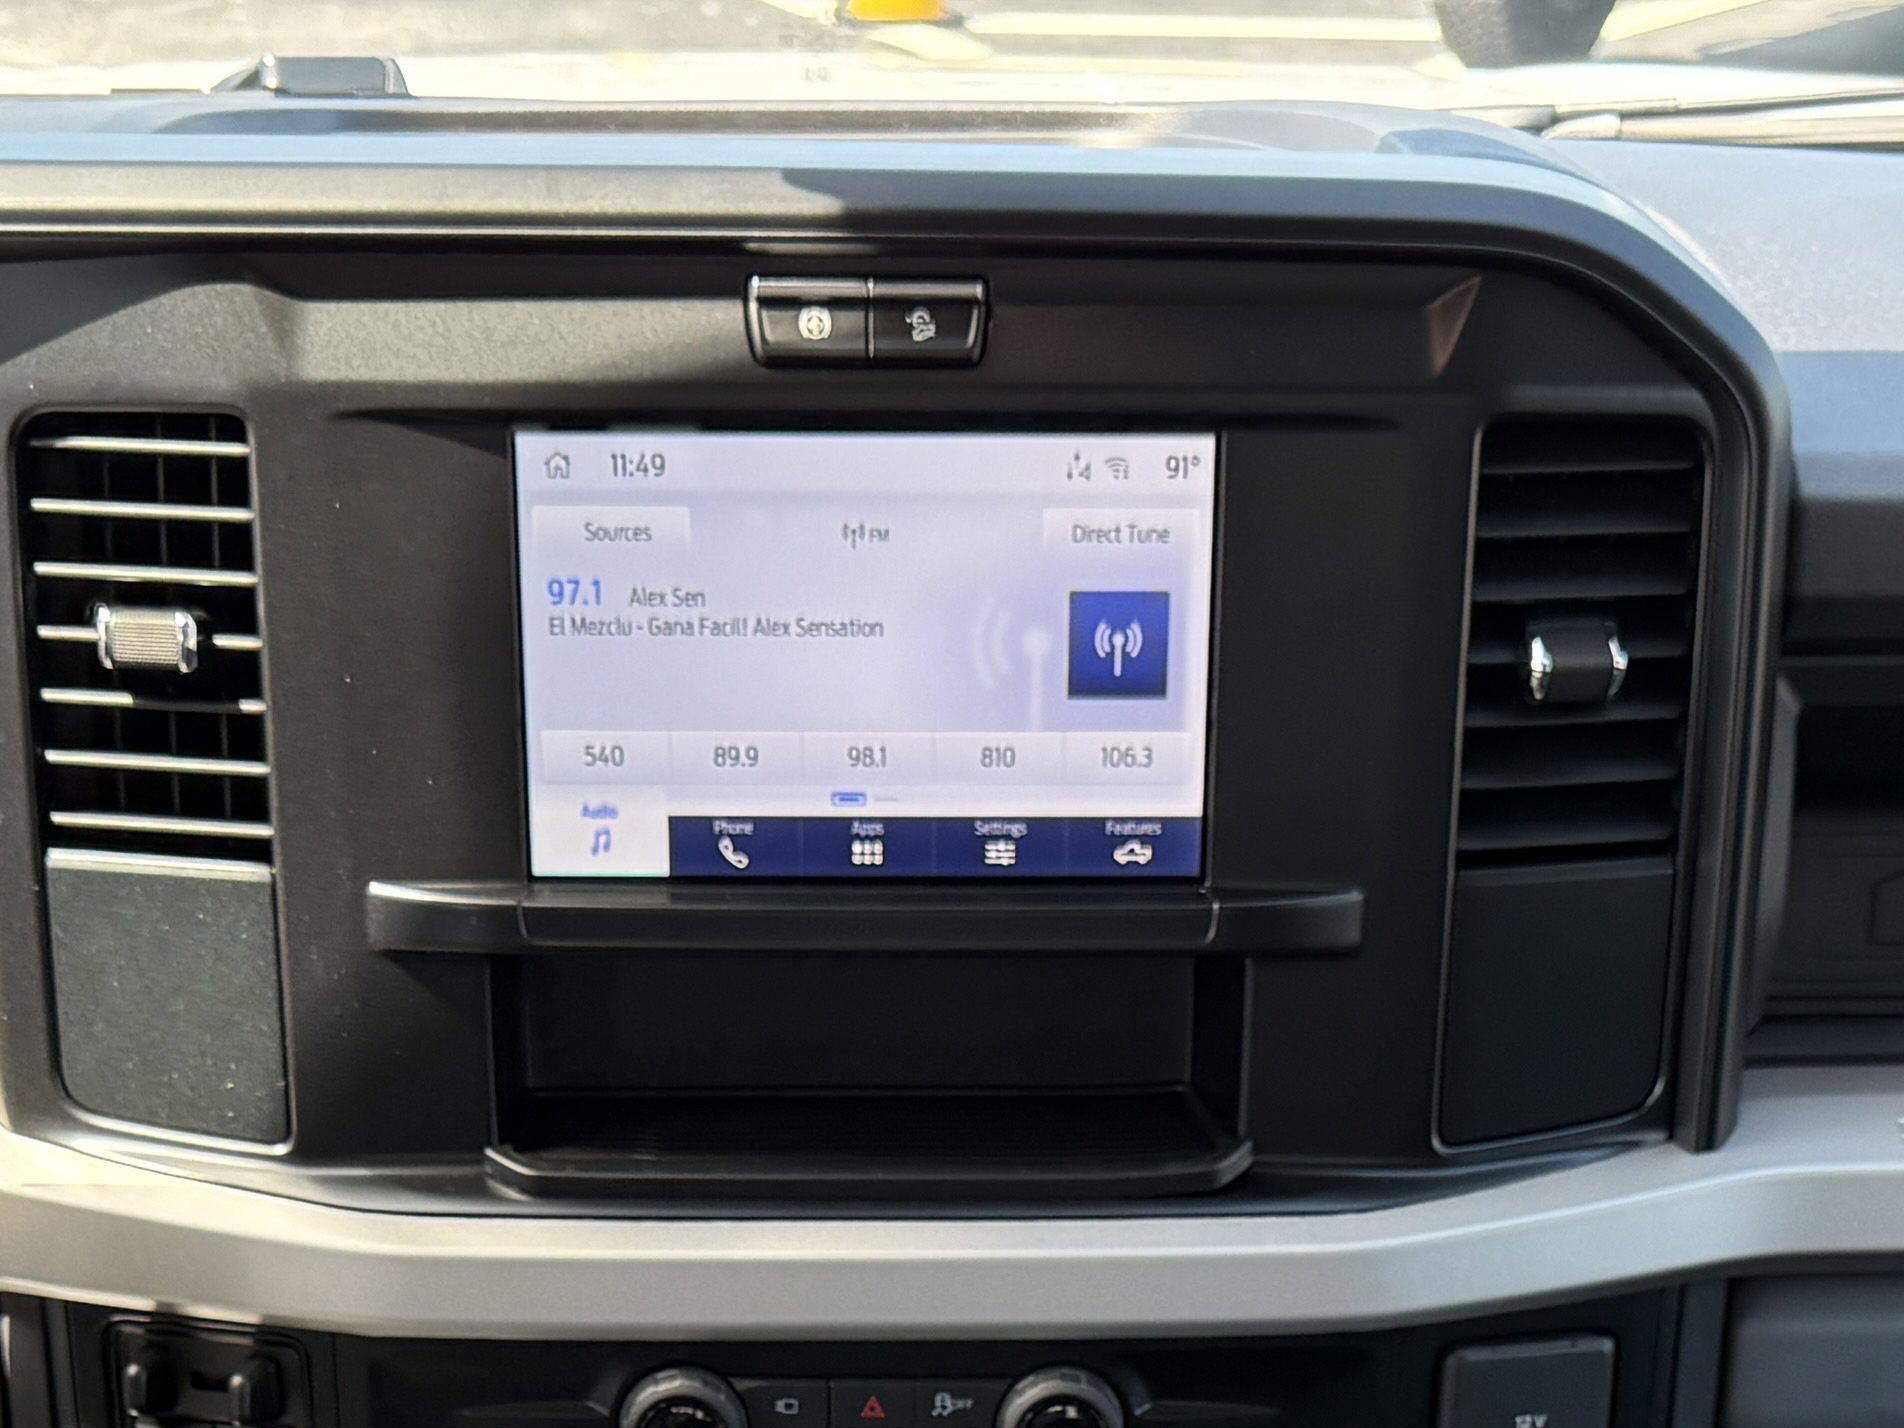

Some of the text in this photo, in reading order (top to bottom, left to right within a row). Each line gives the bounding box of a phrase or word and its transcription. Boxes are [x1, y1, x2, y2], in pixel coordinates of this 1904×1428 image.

[610, 453, 666, 478] 11:49
[584, 521, 652, 542] Sources
[1071, 524, 1171, 544] Direct Tune
[548, 578, 602, 606] 97.1
[629, 588, 707, 608] Alex Sen
[549, 617, 566, 636] El
[571, 616, 633, 637] Mezclu
[647, 617, 695, 637] Gana
[753, 617, 792, 637] Alex
[795, 617, 885, 638] Sensation
[584, 745, 625, 767] 540
[713, 745, 760, 768] 89.9
[848, 746, 887, 768] 98.1
[980, 746, 1016, 768] 810
[1101, 746, 1153, 768] 106.3
[712, 820, 755, 836] Phone
[850, 820, 885, 837] Apps
[974, 819, 1028, 838] Settings
[1105, 820, 1162, 836] Features
